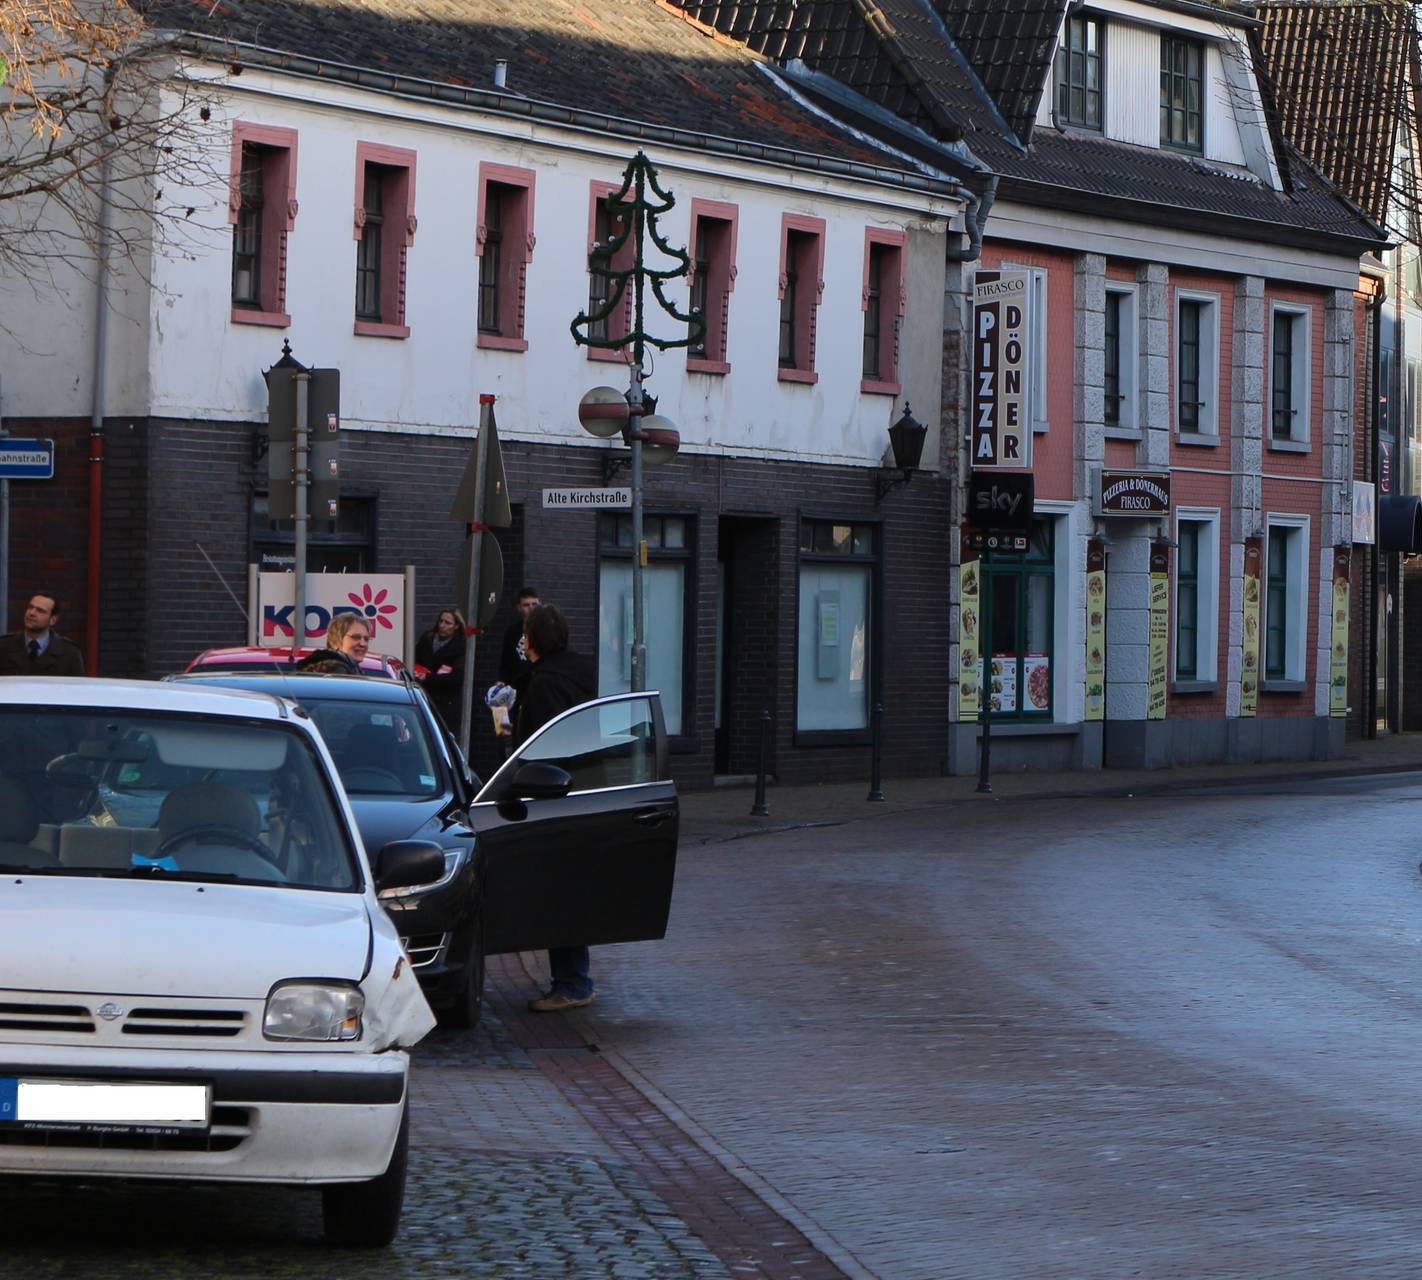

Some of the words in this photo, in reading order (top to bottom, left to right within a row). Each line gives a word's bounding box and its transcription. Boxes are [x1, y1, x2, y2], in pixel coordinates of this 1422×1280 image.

[977, 279, 1024, 297] FIRASCO
[977, 311, 995, 458] PIZZA
[1003, 305, 1022, 459] DÖNER
[547, 492, 567, 504] Alte
[570, 491, 627, 504] Kirchstraße
[976, 485, 1022, 515] sky
[1103, 479, 1129, 504] PIZZERIA
[1121, 496, 1151, 509] FIRASCO
